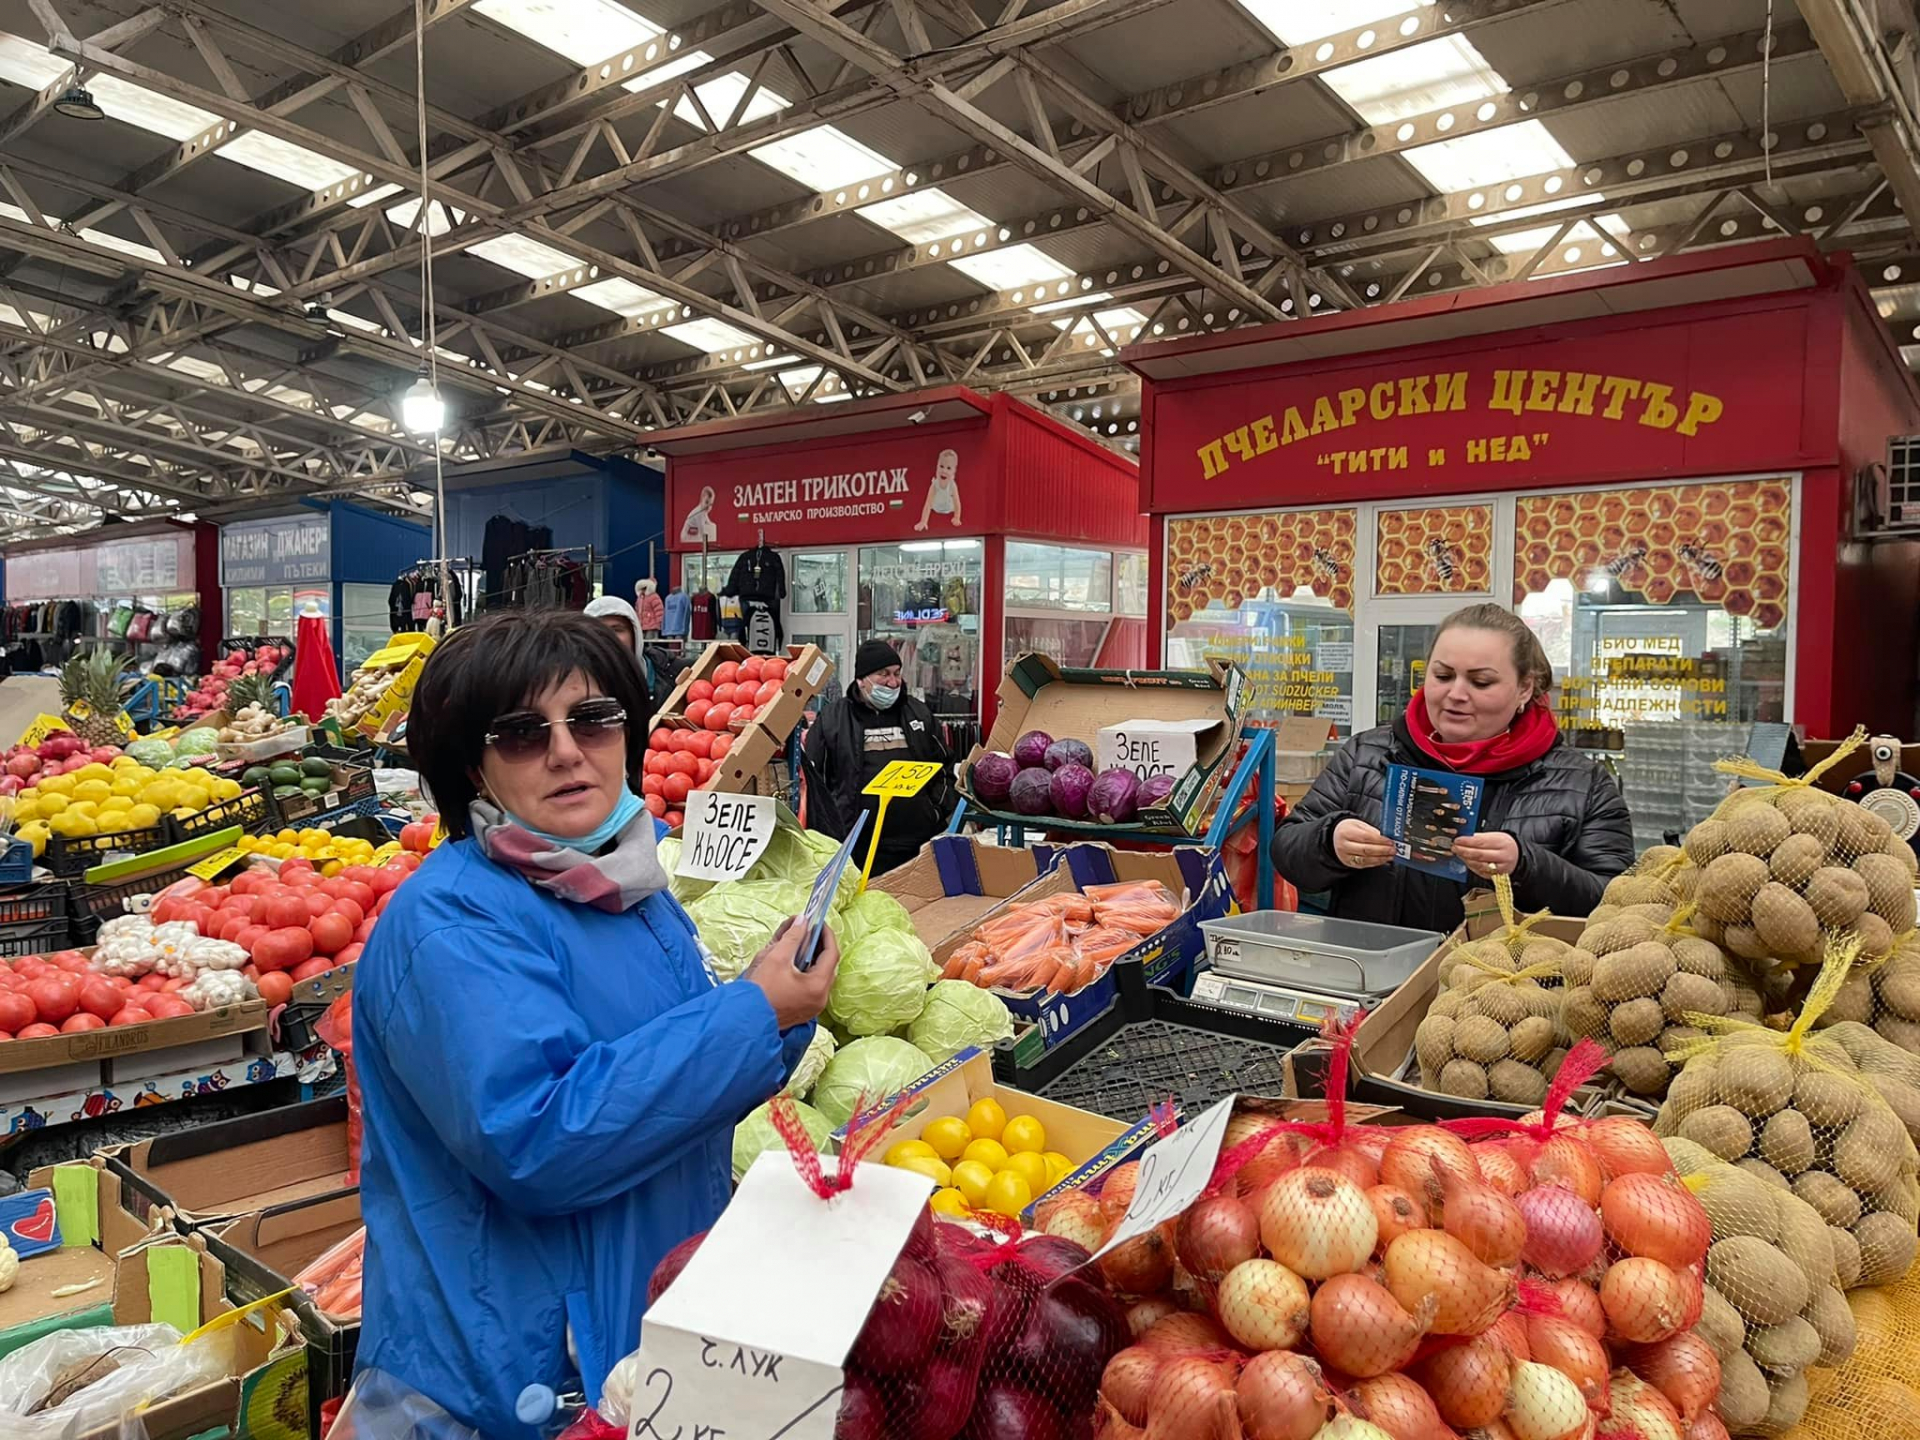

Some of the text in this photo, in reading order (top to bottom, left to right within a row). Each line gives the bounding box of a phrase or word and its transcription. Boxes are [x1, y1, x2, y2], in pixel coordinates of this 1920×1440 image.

[1197, 369, 1724, 481] ПЧЕЛАРСКИ ЦЕНТЪР
[1428, 449, 1445, 466] и
[733, 467, 909, 508] ЗЛАТЕН ТРИКОТАЖ
[753, 502, 885, 524] БЪЛГАРСКО ПРОИЗВОДСТВО
[223, 532, 269, 561] МАГАЗИН
[284, 561, 327, 578] ПЪТЕКИ
[1603, 637, 1681, 651] БИО МЕД
[1591, 656, 1693, 671] ПРЕПАРАТИ
[1273, 670, 1288, 681] ЗА
[1291, 671, 1335, 683] ПЧЕЛИ
[1650, 678, 1725, 692] ОСНОВИ
[730, 1347, 783, 1382] ЛУК
